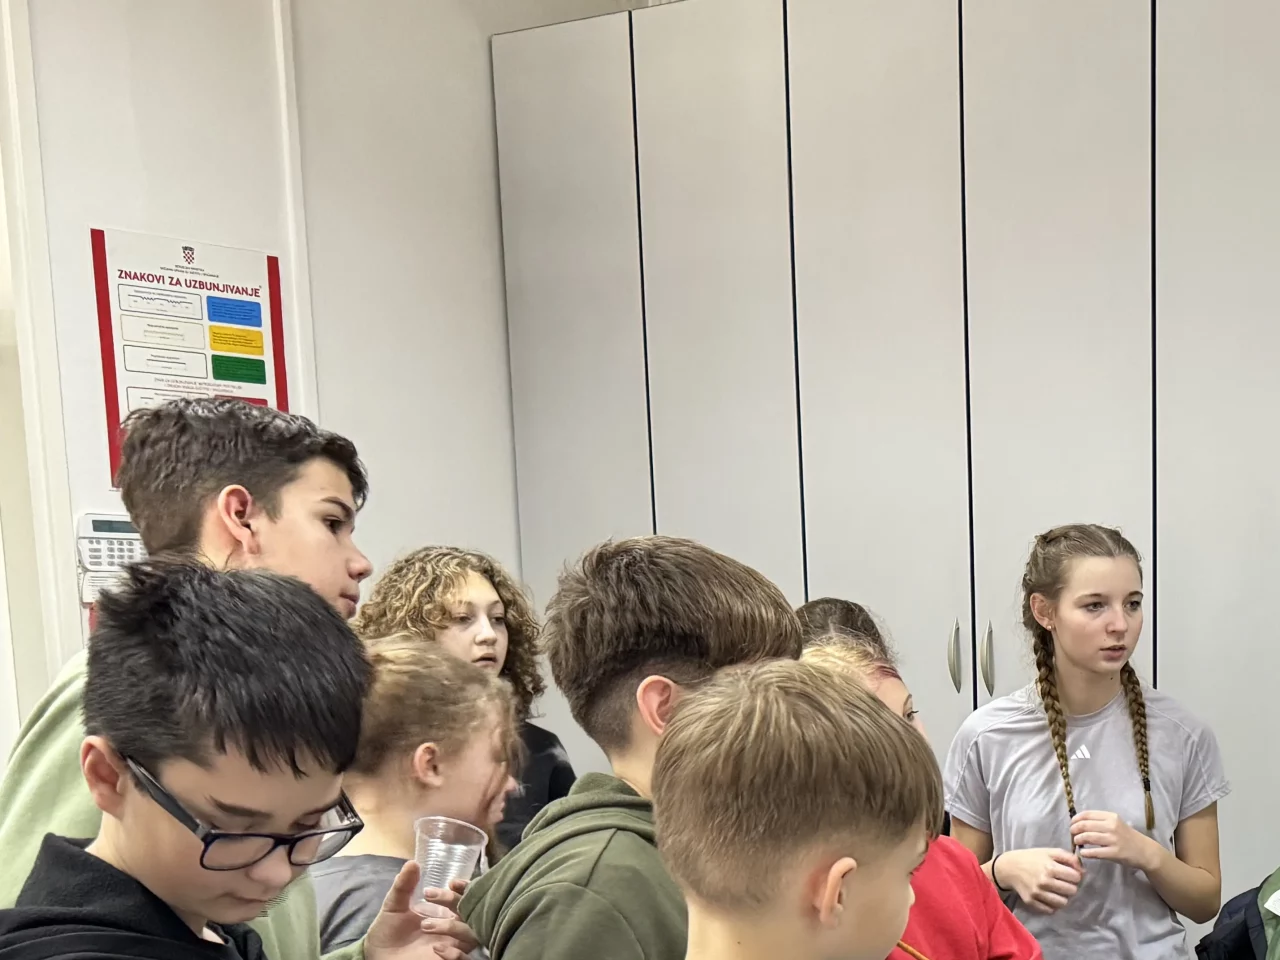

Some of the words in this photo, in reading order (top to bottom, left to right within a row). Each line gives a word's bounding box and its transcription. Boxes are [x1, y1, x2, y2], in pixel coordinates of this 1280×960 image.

[117, 269, 165, 285] ZNAKOVI
[168, 276, 182, 287] ZA
[185, 279, 260, 297] UZBUNJIVANJE
